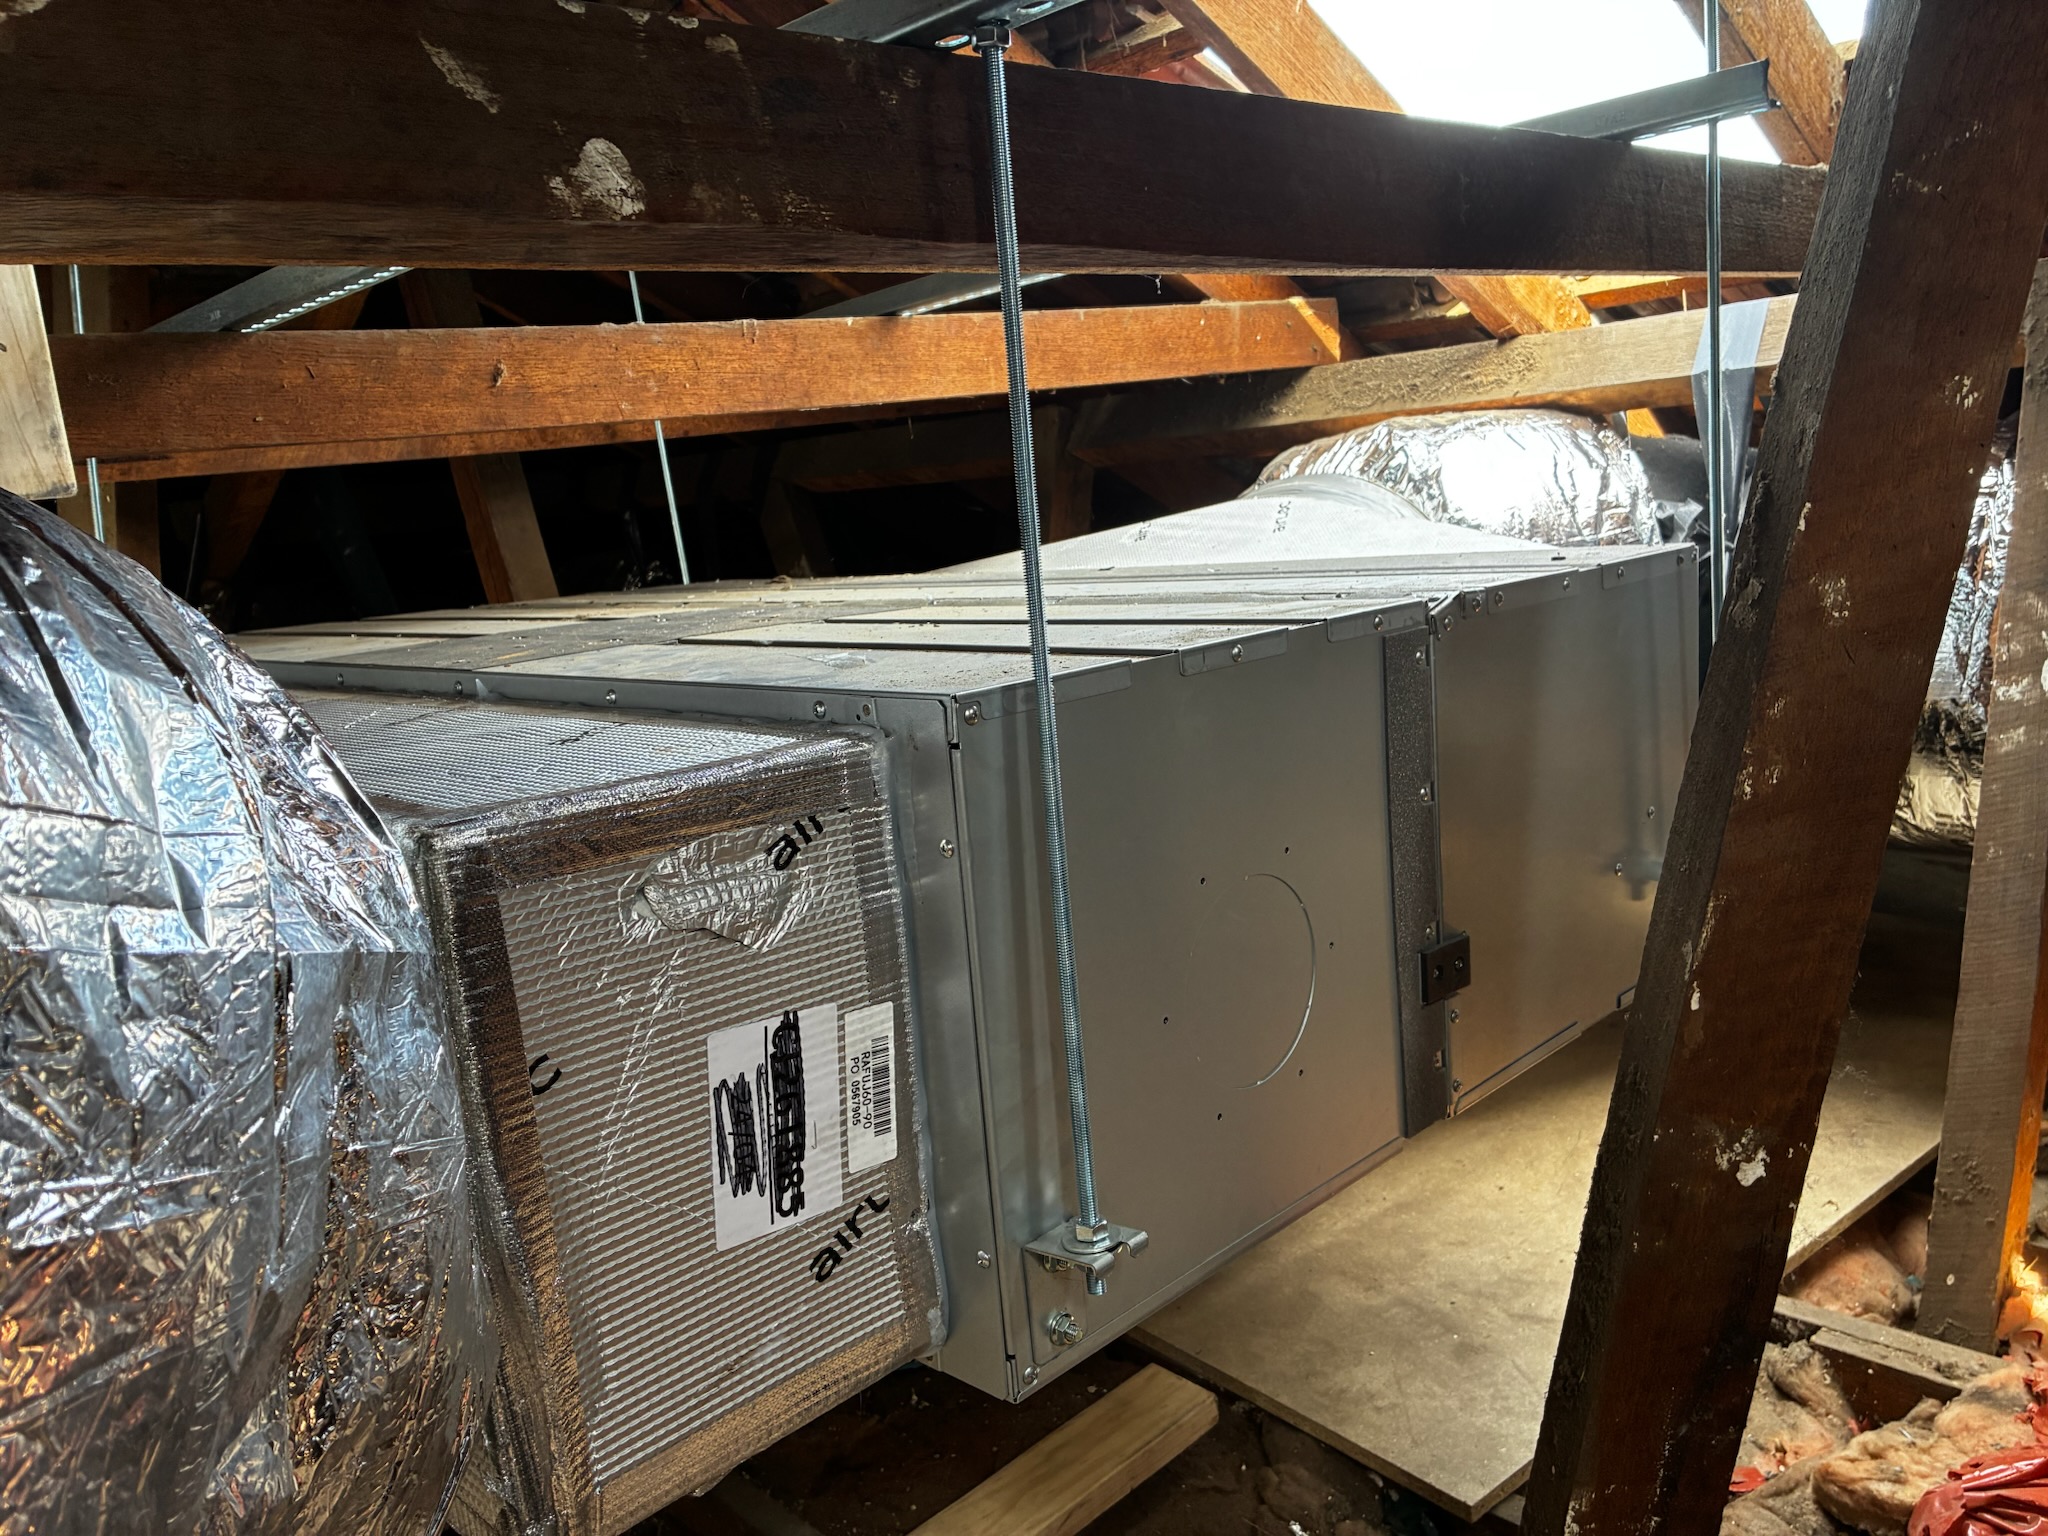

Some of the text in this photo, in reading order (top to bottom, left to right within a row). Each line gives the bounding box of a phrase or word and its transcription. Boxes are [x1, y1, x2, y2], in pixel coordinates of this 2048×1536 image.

[850, 1057, 861, 1127] PO 0567905
[861, 1051, 873, 1130] RAFUJ60-90
